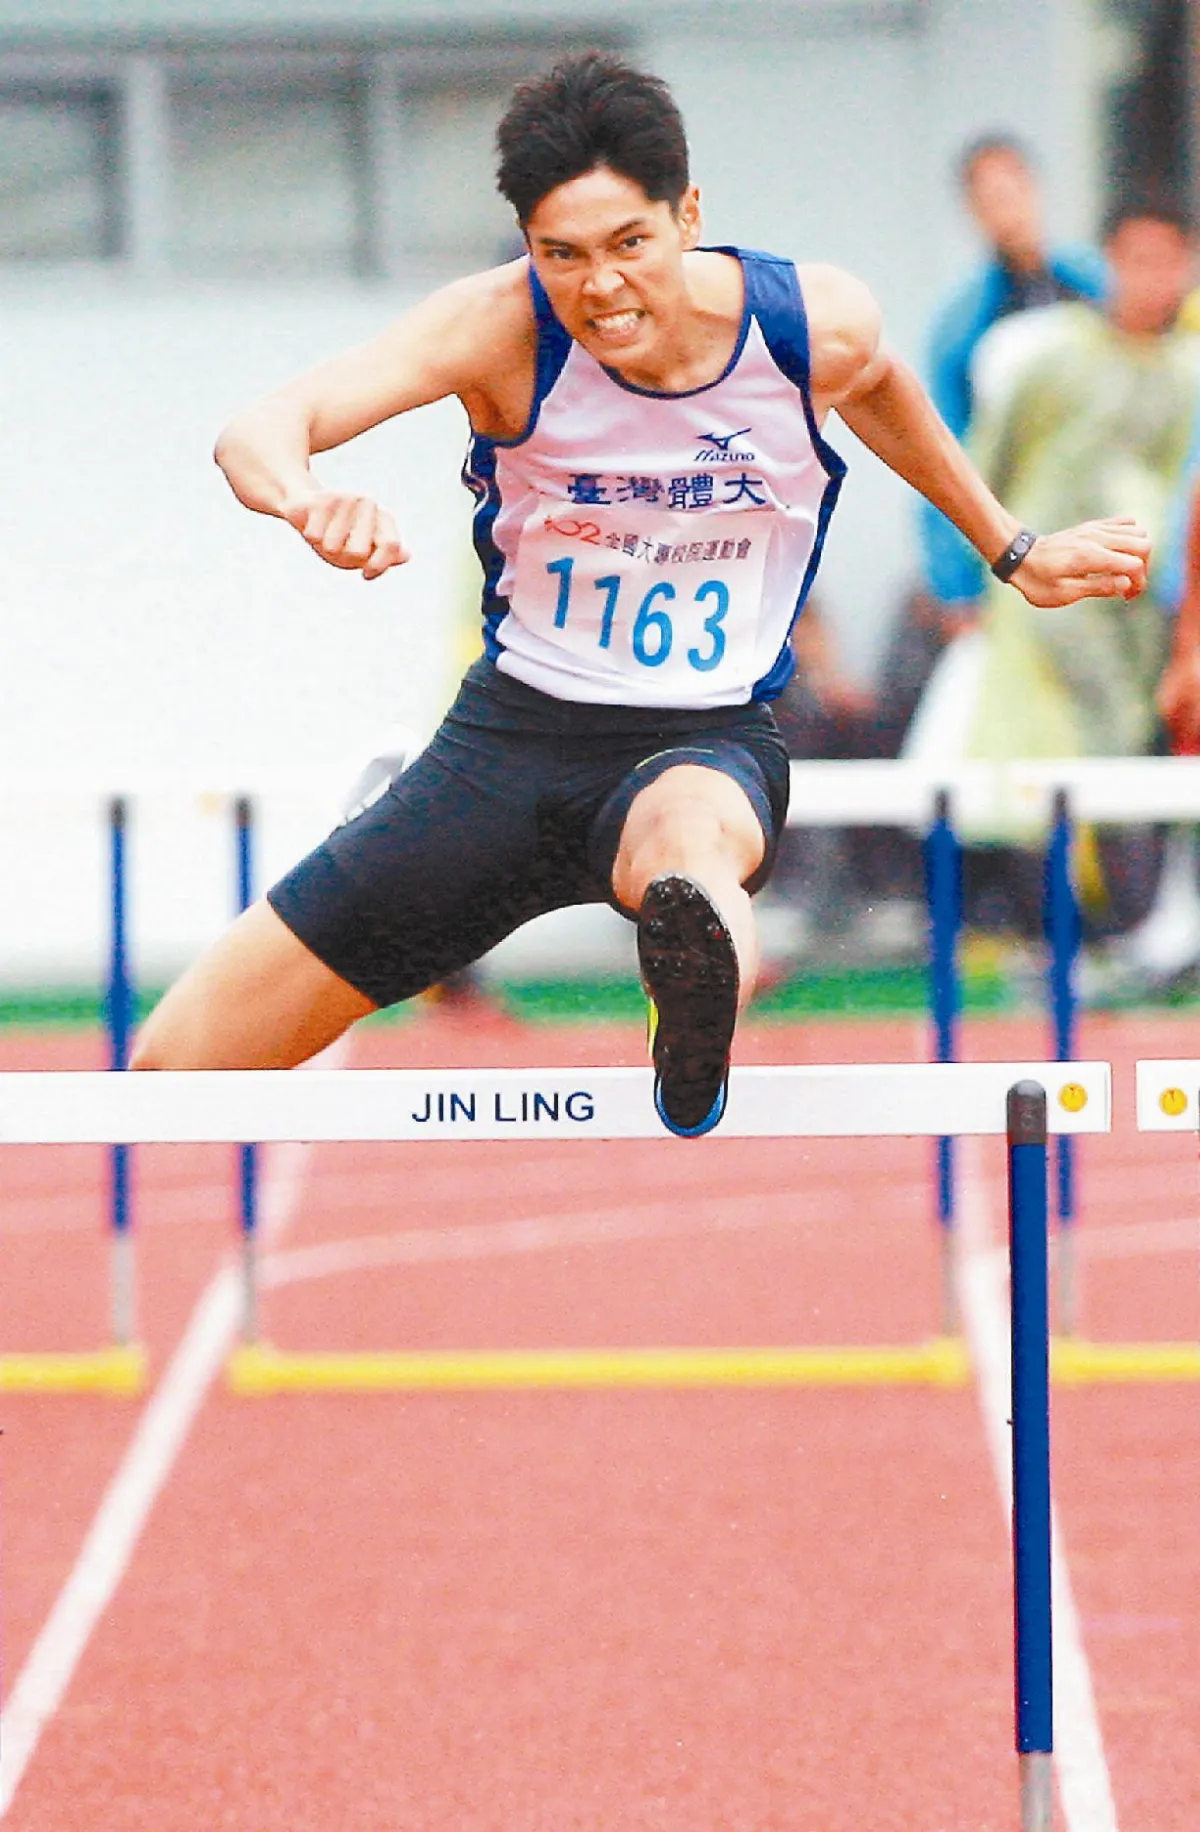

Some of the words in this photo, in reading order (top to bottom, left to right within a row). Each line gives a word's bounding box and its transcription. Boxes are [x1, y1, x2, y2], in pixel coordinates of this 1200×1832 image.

[567, 472, 767, 509] 臺灣體大
[546, 556, 729, 673] 1163
[411, 1093, 476, 1122] JIN
[495, 1091, 595, 1122] LING
